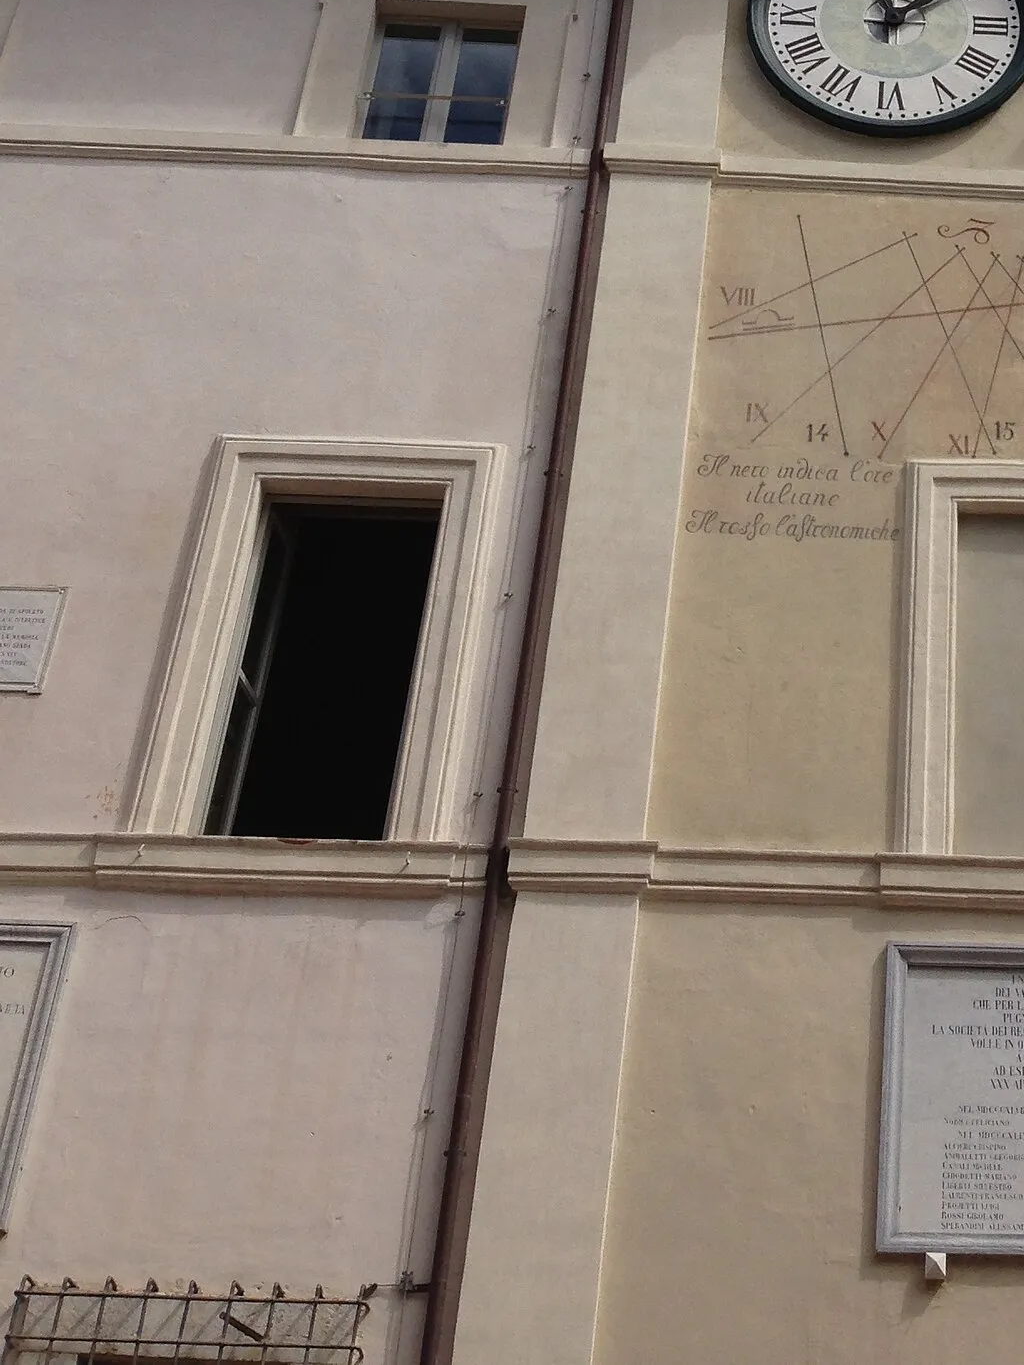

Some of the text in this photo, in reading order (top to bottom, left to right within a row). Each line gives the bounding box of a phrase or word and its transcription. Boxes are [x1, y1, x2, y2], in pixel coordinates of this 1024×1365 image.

[780, 4, 817, 27] IX
[973, 16, 1008, 36] III
[785, 33, 830, 74] VIII
[955, 45, 999, 79] IIII
[820, 64, 862, 102] VII
[932, 76, 957, 104] V
[878, 81, 905, 110] VI
[719, 286, 755, 307] VIII
[745, 403, 769, 423] IX
[806, 423, 829, 442] 14
[871, 421, 887, 441] X
[994, 421, 1016, 440] 15
[949, 433, 969, 455] XI
[730, 465, 770, 480] nero
[777, 458, 839, 482] indica
[745, 481, 841, 507] italiane
[996, 987, 1010, 997] DEI
[973, 1000, 991, 1010] CHE
[995, 1000, 1014, 1011] PER
[932, 1024, 944, 1035] LA
[992, 1025, 1007, 1036] DEI
[970, 1038, 1001, 1049] VOLLE
[1005, 1039, 1014, 1049] IN
[994, 1065, 1006, 1076] AD
